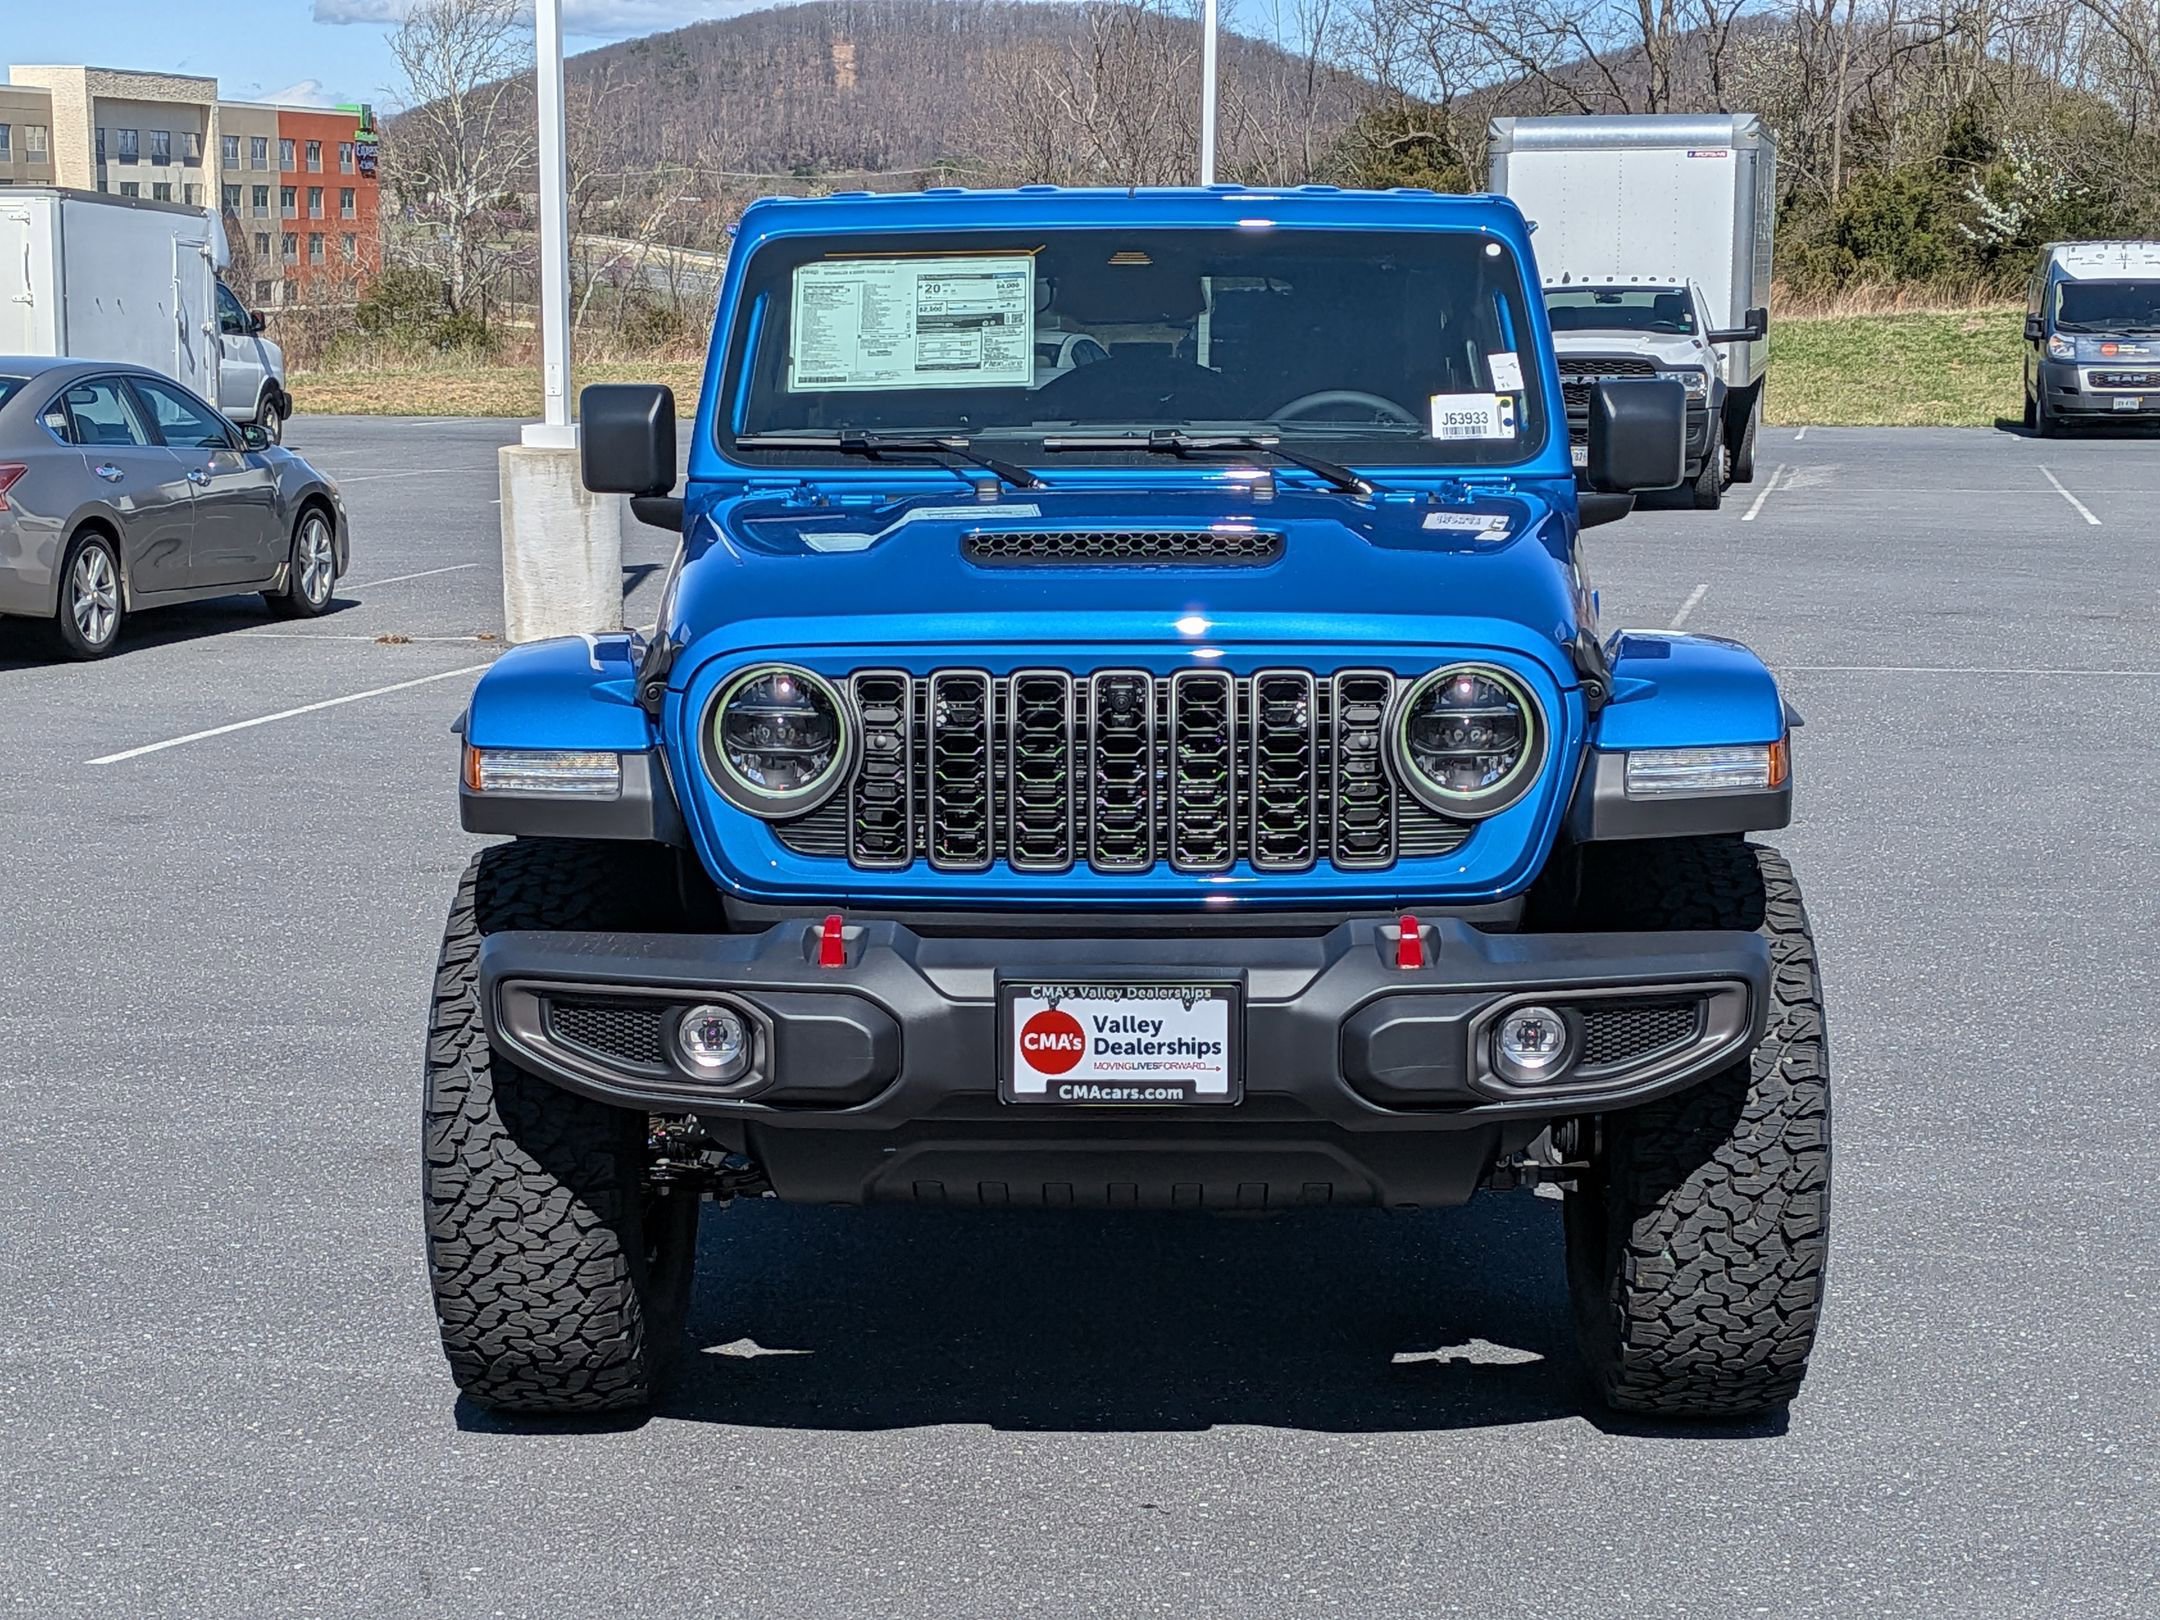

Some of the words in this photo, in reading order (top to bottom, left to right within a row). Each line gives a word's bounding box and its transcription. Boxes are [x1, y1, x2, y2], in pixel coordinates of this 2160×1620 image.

[925, 284, 941, 293] 20
[1442, 411, 1488, 425] J63933
[1030, 986, 1075, 999] CMA's
[1079, 987, 1123, 1002] Valley
[1127, 986, 1212, 1001] Dealerships
[1092, 1015, 1164, 1037] Valley
[1023, 1032, 1083, 1051] CMA's
[1093, 1037, 1222, 1059] Dealerships
[1058, 1085, 1184, 1100] CMAcars.com
